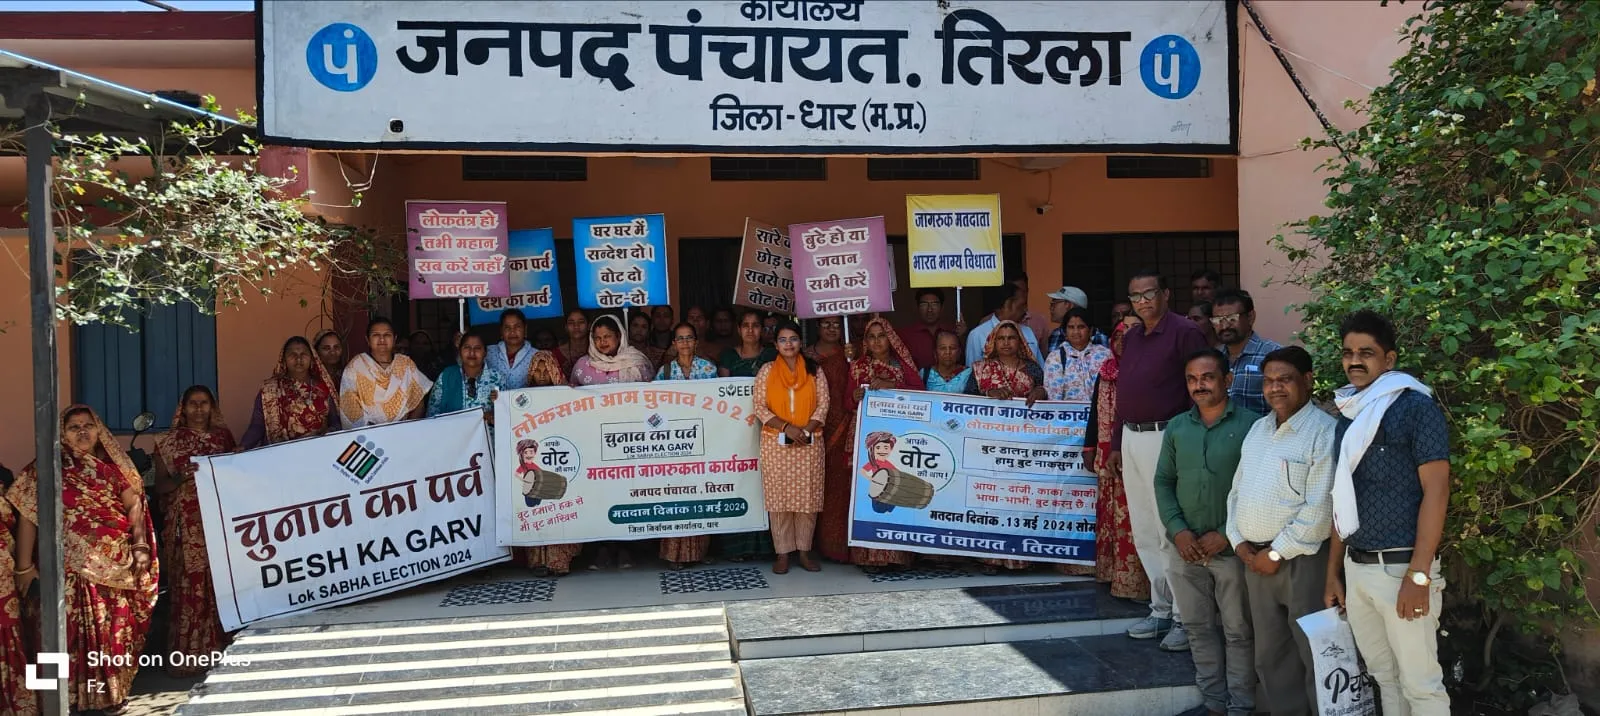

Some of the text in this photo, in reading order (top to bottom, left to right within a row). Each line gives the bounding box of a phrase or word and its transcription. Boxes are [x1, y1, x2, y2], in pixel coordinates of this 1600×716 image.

[396, 21, 641, 91] जनपद
[935, 9, 1131, 87] तिरला
[422, 210, 496, 228] लोकतंत्र हो
[955, 211, 990, 227] मतदाता
[593, 220, 646, 237] घर घर में
[756, 228, 781, 246] सारे
[830, 228, 846, 244] हो
[849, 230, 866, 241] या
[424, 233, 495, 249] तभी महान
[531, 252, 550, 270] पर्व
[587, 244, 629, 261] सन्देश
[757, 248, 781, 269] छोड़
[816, 253, 858, 267] जवान
[913, 248, 996, 270] भारत भाग्य विधाता
[418, 255, 504, 272] सब करें जहाँ
[601, 266, 643, 283] वोट दो
[745, 270, 779, 288] सबसे
[808, 274, 841, 290] सभी
[844, 271, 868, 288] करें
[436, 283, 486, 295] मतदान
[506, 294, 526, 306] का
[527, 288, 548, 305] गर्व
[748, 288, 772, 307] वोट
[774, 294, 789, 311] दो
[816, 299, 867, 312] मतदान
[511, 390, 757, 439] लोकसभा आम चुनाव 2024
[942, 401, 995, 417] मतदाता
[966, 418, 1021, 433] लोकसभा
[604, 424, 699, 448] चुनाव का पर्व
[540, 447, 570, 466] वोट
[623, 442, 695, 454] DESH KA GARV
[1062, 451, 1080, 460] हक
[898, 446, 941, 469] वोट
[587, 465, 635, 480] मतदाता
[709, 454, 759, 474] कार्यक्रम
[630, 486, 662, 497] जनपद
[664, 483, 697, 495] पंचायत
[705, 481, 735, 493] तिरला
[231, 494, 353, 562] चुनाव
[360, 479, 418, 520] का
[424, 452, 485, 504] पर्व
[611, 501, 746, 519] मतदान दिनांक 13 मई 2024
[930, 510, 965, 523] मतदान
[966, 509, 999, 526] दिनांक
[1022, 515, 1040, 530] मई
[1043, 519, 1073, 532] 2024
[875, 528, 937, 544] जनपद
[940, 531, 1007, 551] पंचायत
[1022, 538, 1080, 556] तिरला
[260, 514, 482, 589] DESH KA GARV
[288, 548, 473, 607] Lok SABHA ELECTION 2024
